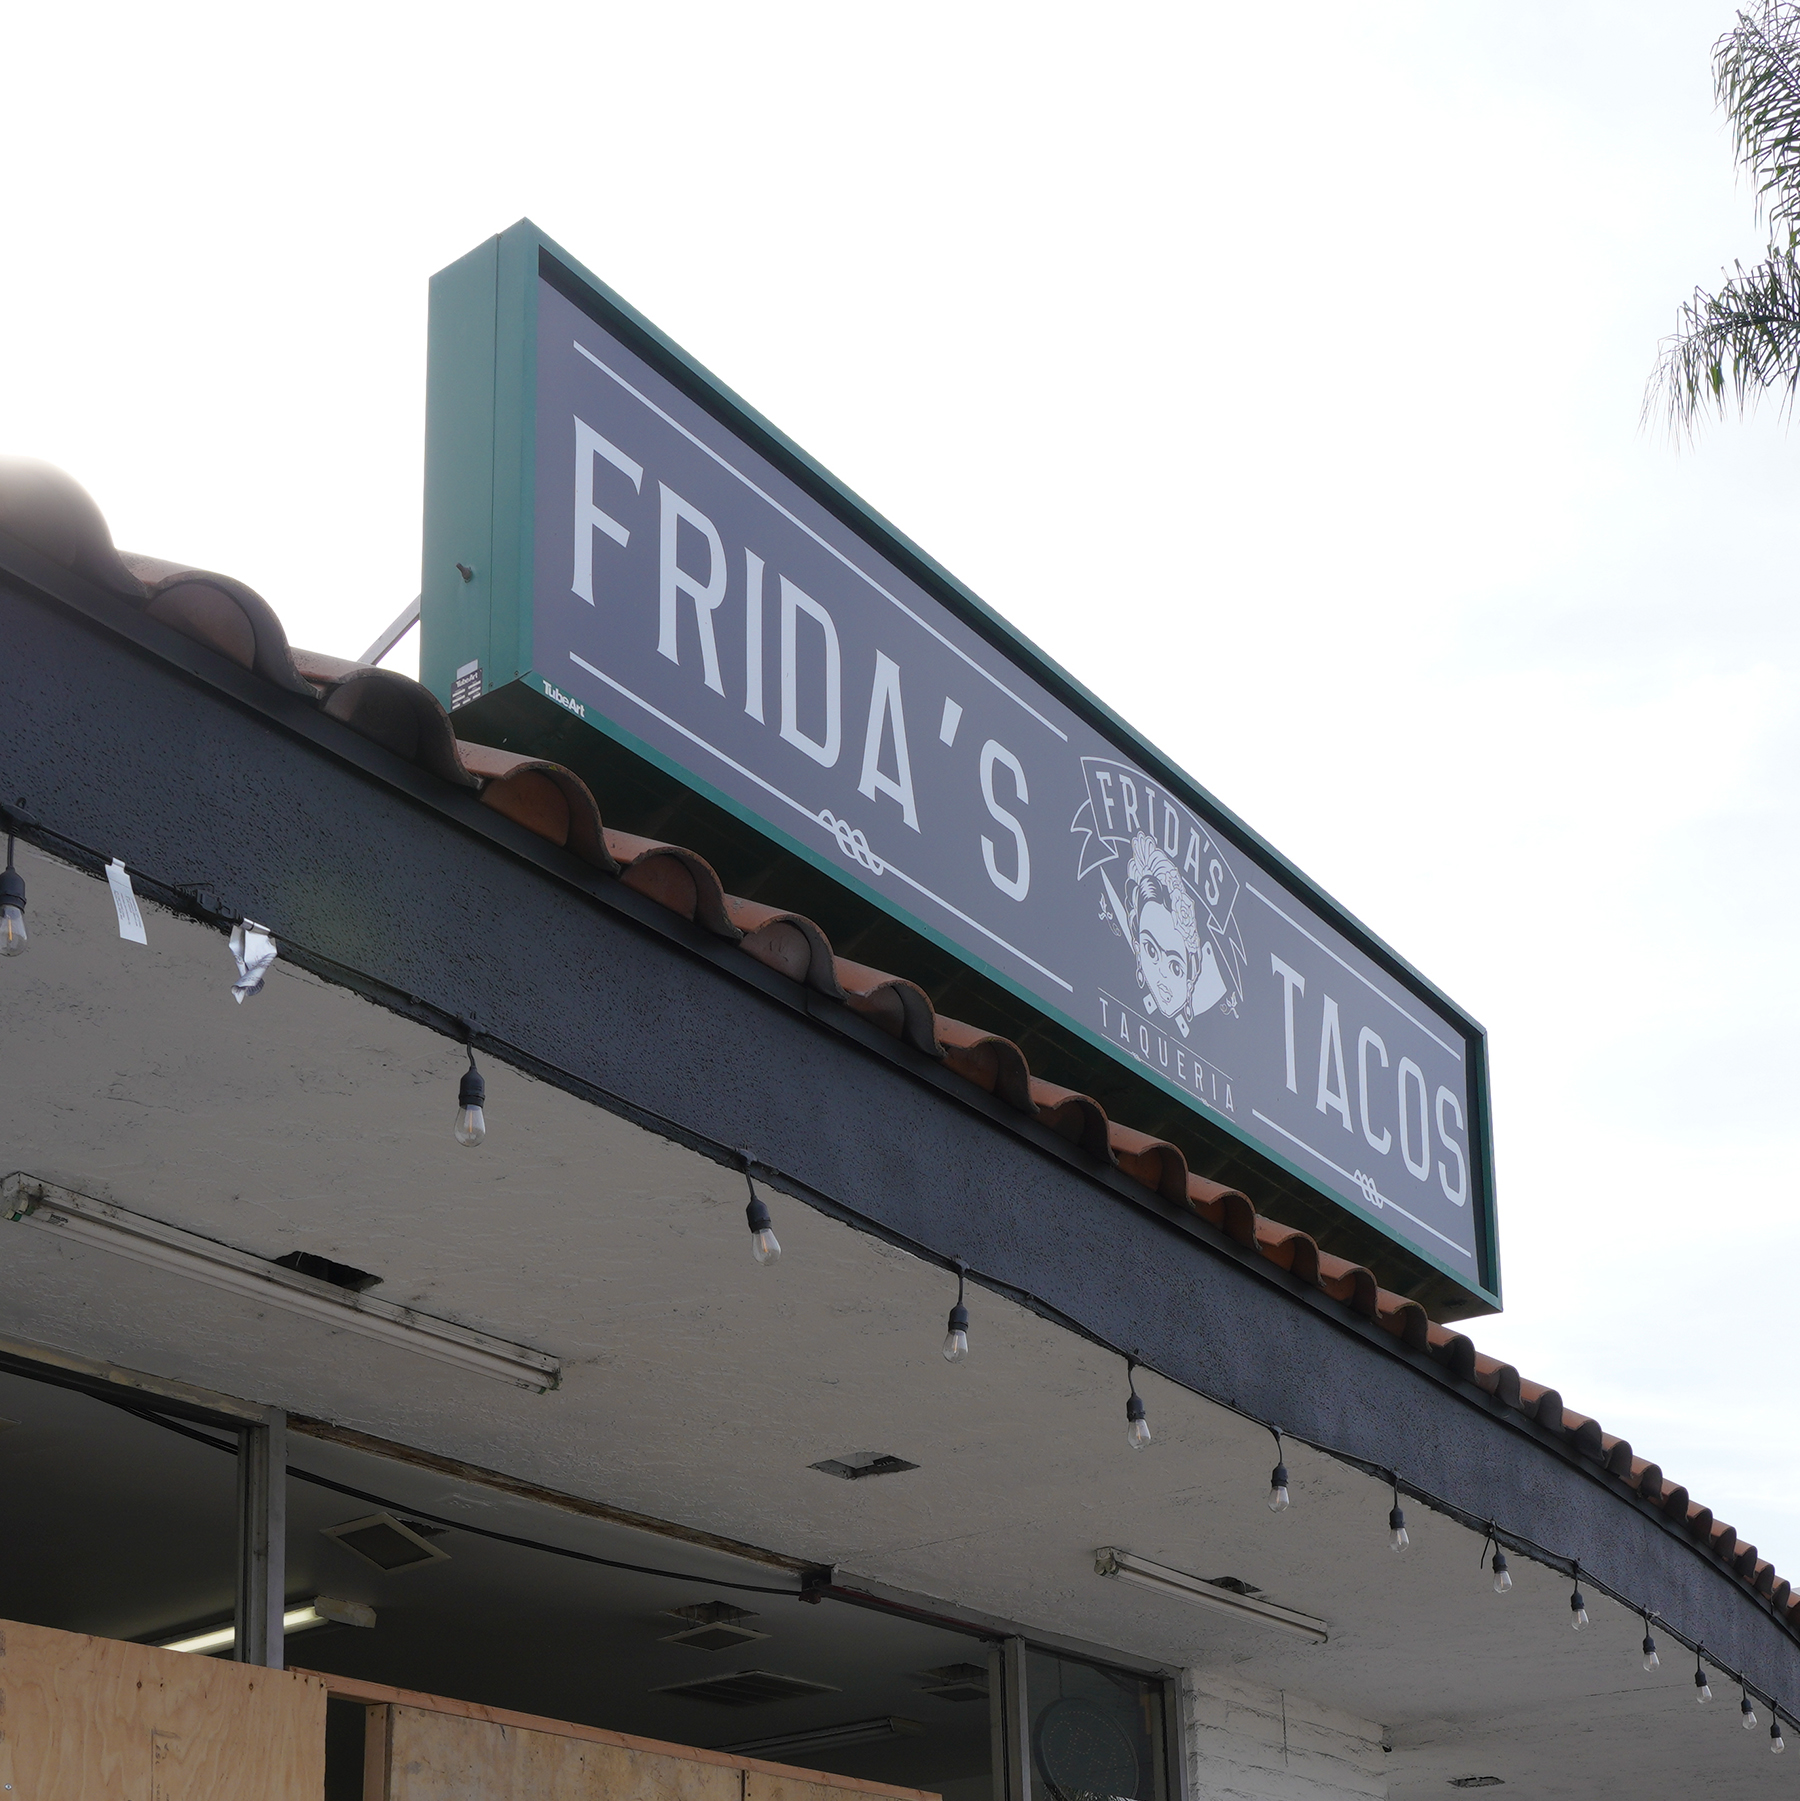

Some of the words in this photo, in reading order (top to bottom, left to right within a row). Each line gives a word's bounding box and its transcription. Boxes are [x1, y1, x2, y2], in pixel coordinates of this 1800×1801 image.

[542, 679, 586, 718] TubeArt
[570, 415, 1034, 903] FRIDA'S
[1095, 771, 1225, 906] FRIDA'S
[1099, 997, 1235, 1114] TAQUERIA
[1271, 953, 1470, 1207] TACOS
